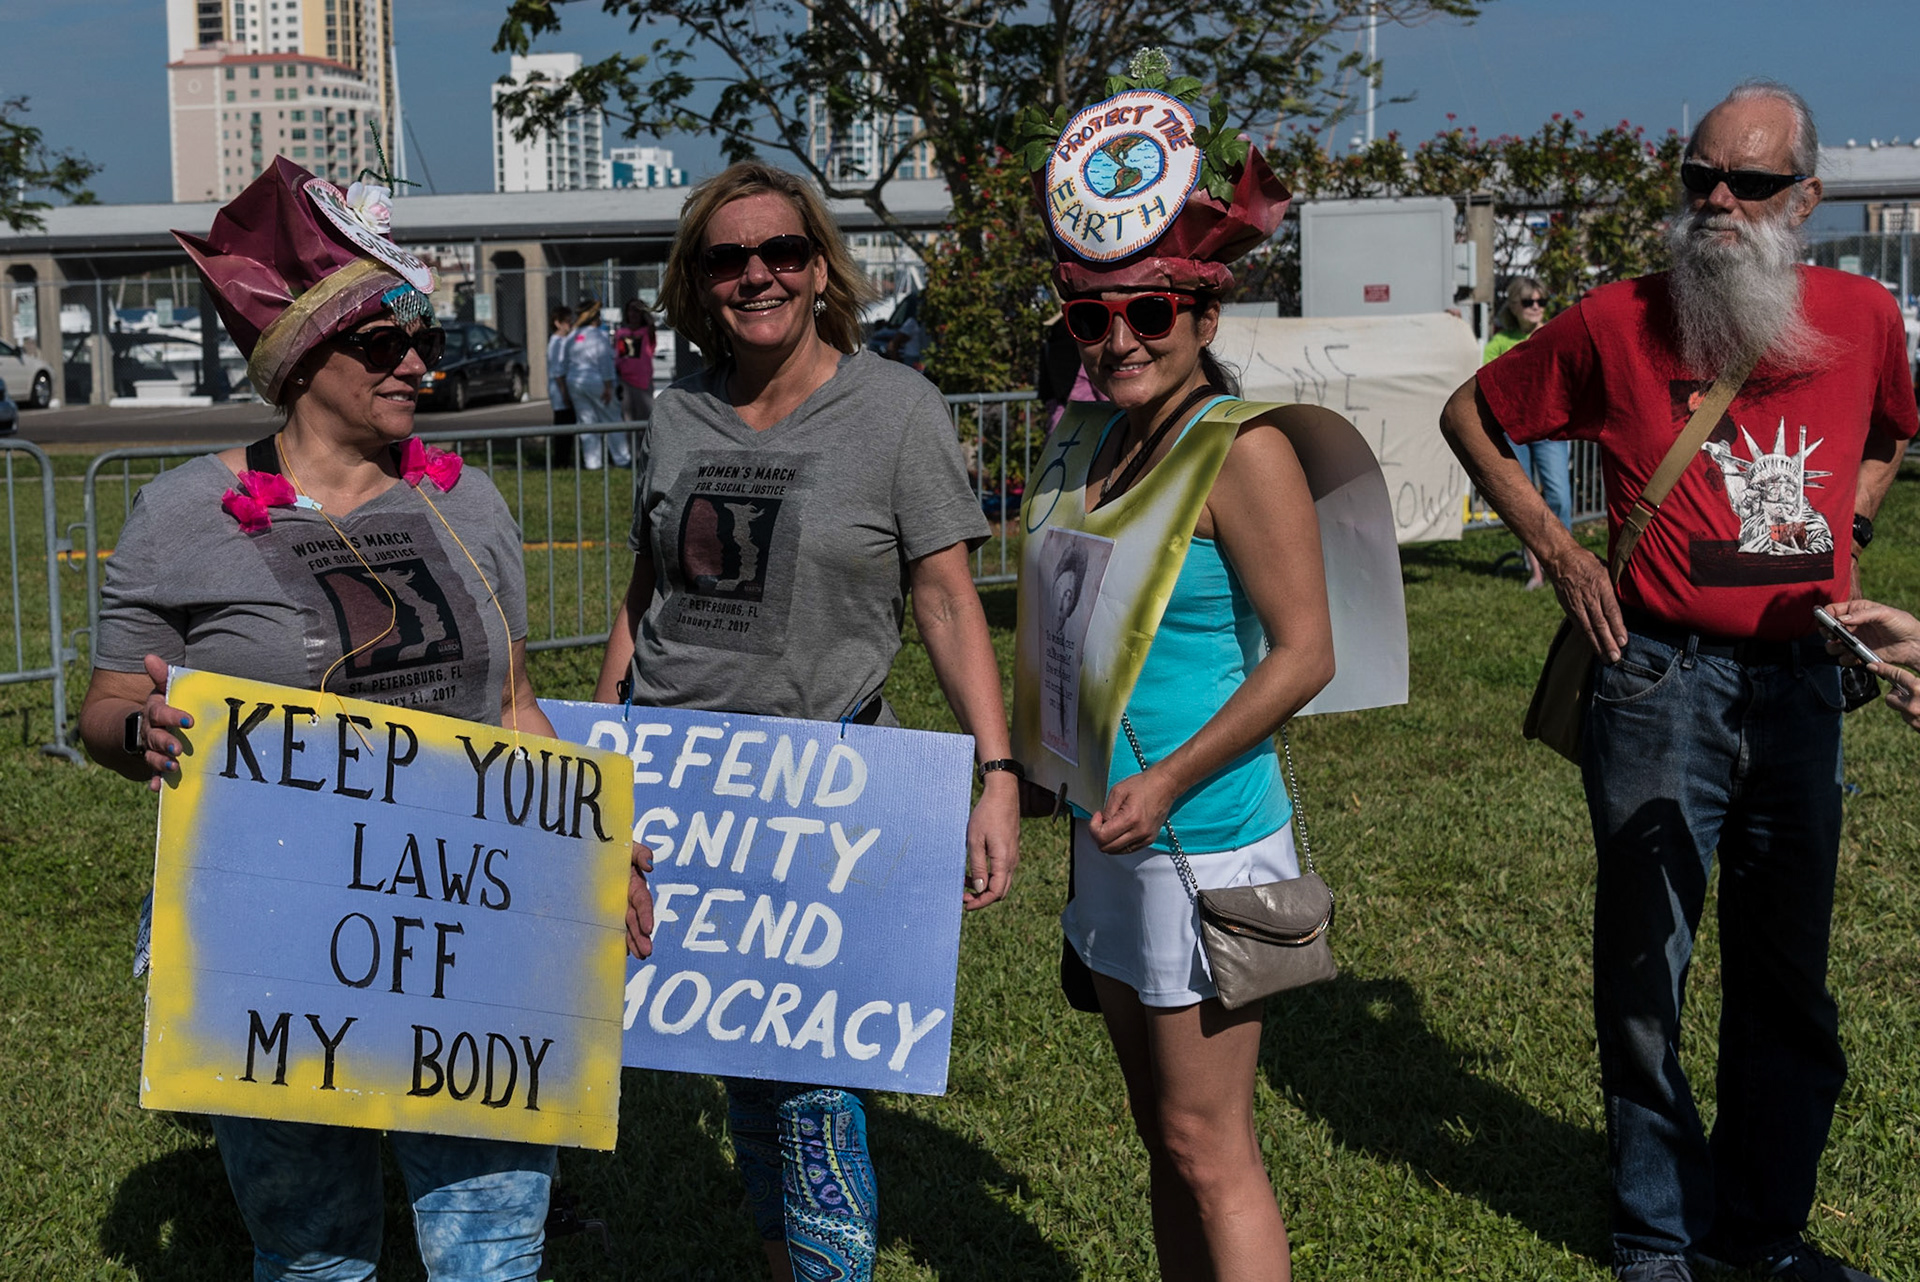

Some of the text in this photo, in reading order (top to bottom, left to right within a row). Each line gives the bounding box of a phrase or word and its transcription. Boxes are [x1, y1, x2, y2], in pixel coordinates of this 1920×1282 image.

[1056, 105, 1195, 163] PROTECT THE
[1050, 178, 1167, 243] EARTH
[694, 482, 786, 496] FOR SOCIAL JUSTICE
[697, 465, 797, 482] WOMEN'S MARCH
[292, 532, 413, 557] WOMENS MARCH
[307, 557, 332, 571] FOR
[374, 547, 418, 562] JUSTICE
[677, 612, 711, 631] January
[728, 619, 751, 634] 2017
[747, 606, 759, 618] FL
[349, 682, 367, 694] ST.
[451, 665, 463, 679] FL
[432, 685, 456, 701] 2017
[219, 697, 614, 842] KEEP YOUR
[347, 823, 511, 911] LAWS
[633, 806, 881, 893] GNITY
[648, 883, 843, 969] FEND
[330, 912, 465, 999] OFF
[239, 1009, 555, 1111] MY BODY
